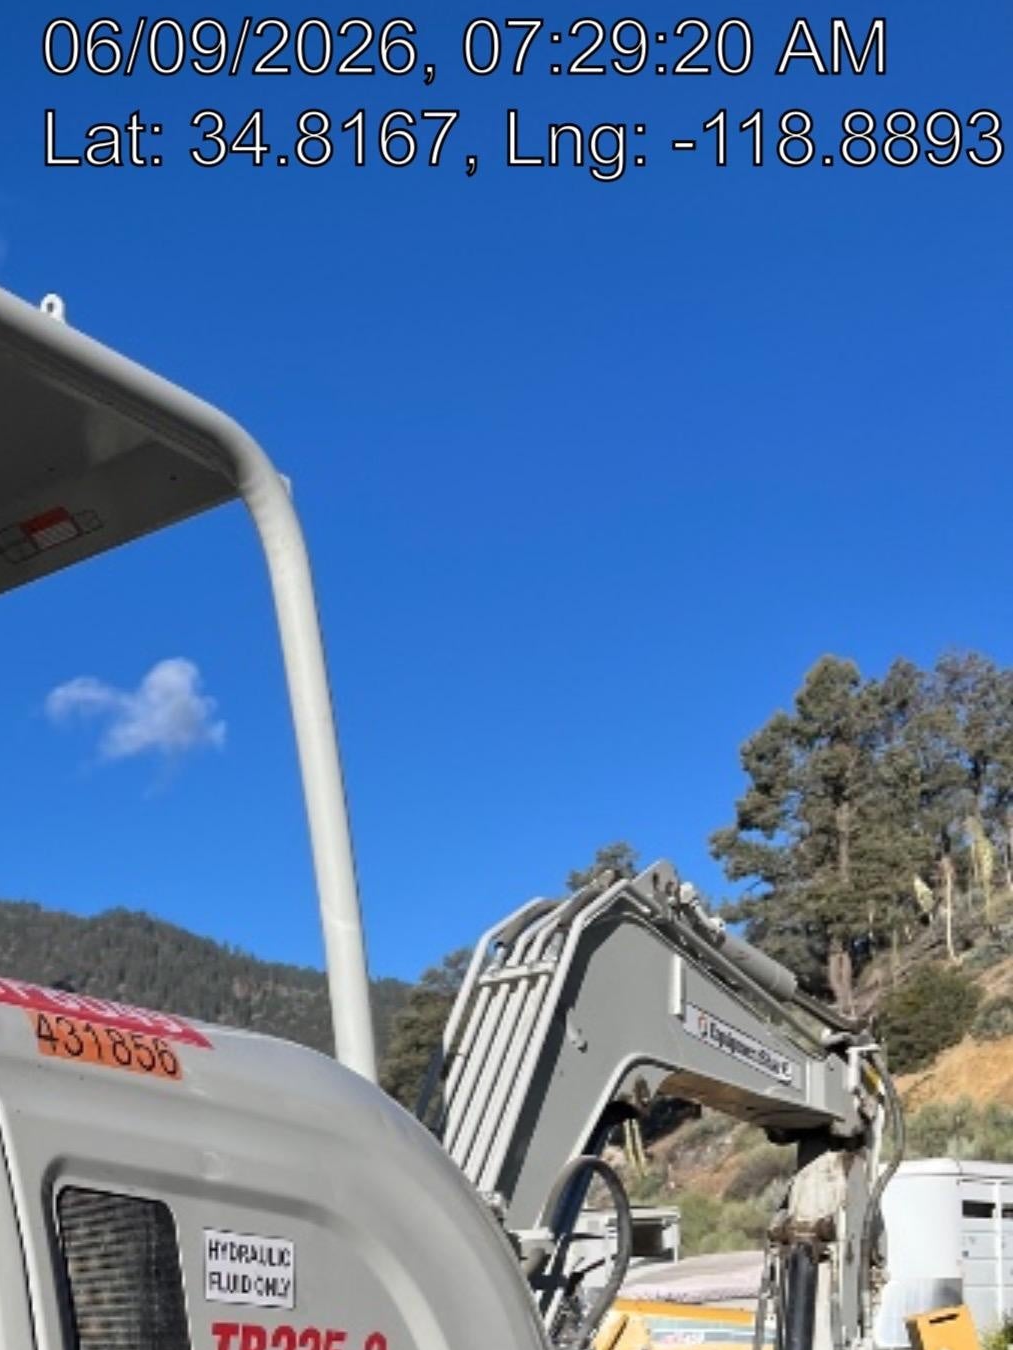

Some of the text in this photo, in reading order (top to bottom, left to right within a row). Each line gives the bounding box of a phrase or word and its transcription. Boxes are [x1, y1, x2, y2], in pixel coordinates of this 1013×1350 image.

[37, 1012, 179, 1076] 431856
[208, 1239, 291, 1267] HYDRAULIC
[209, 1271, 291, 1297] FLUID ONLY
